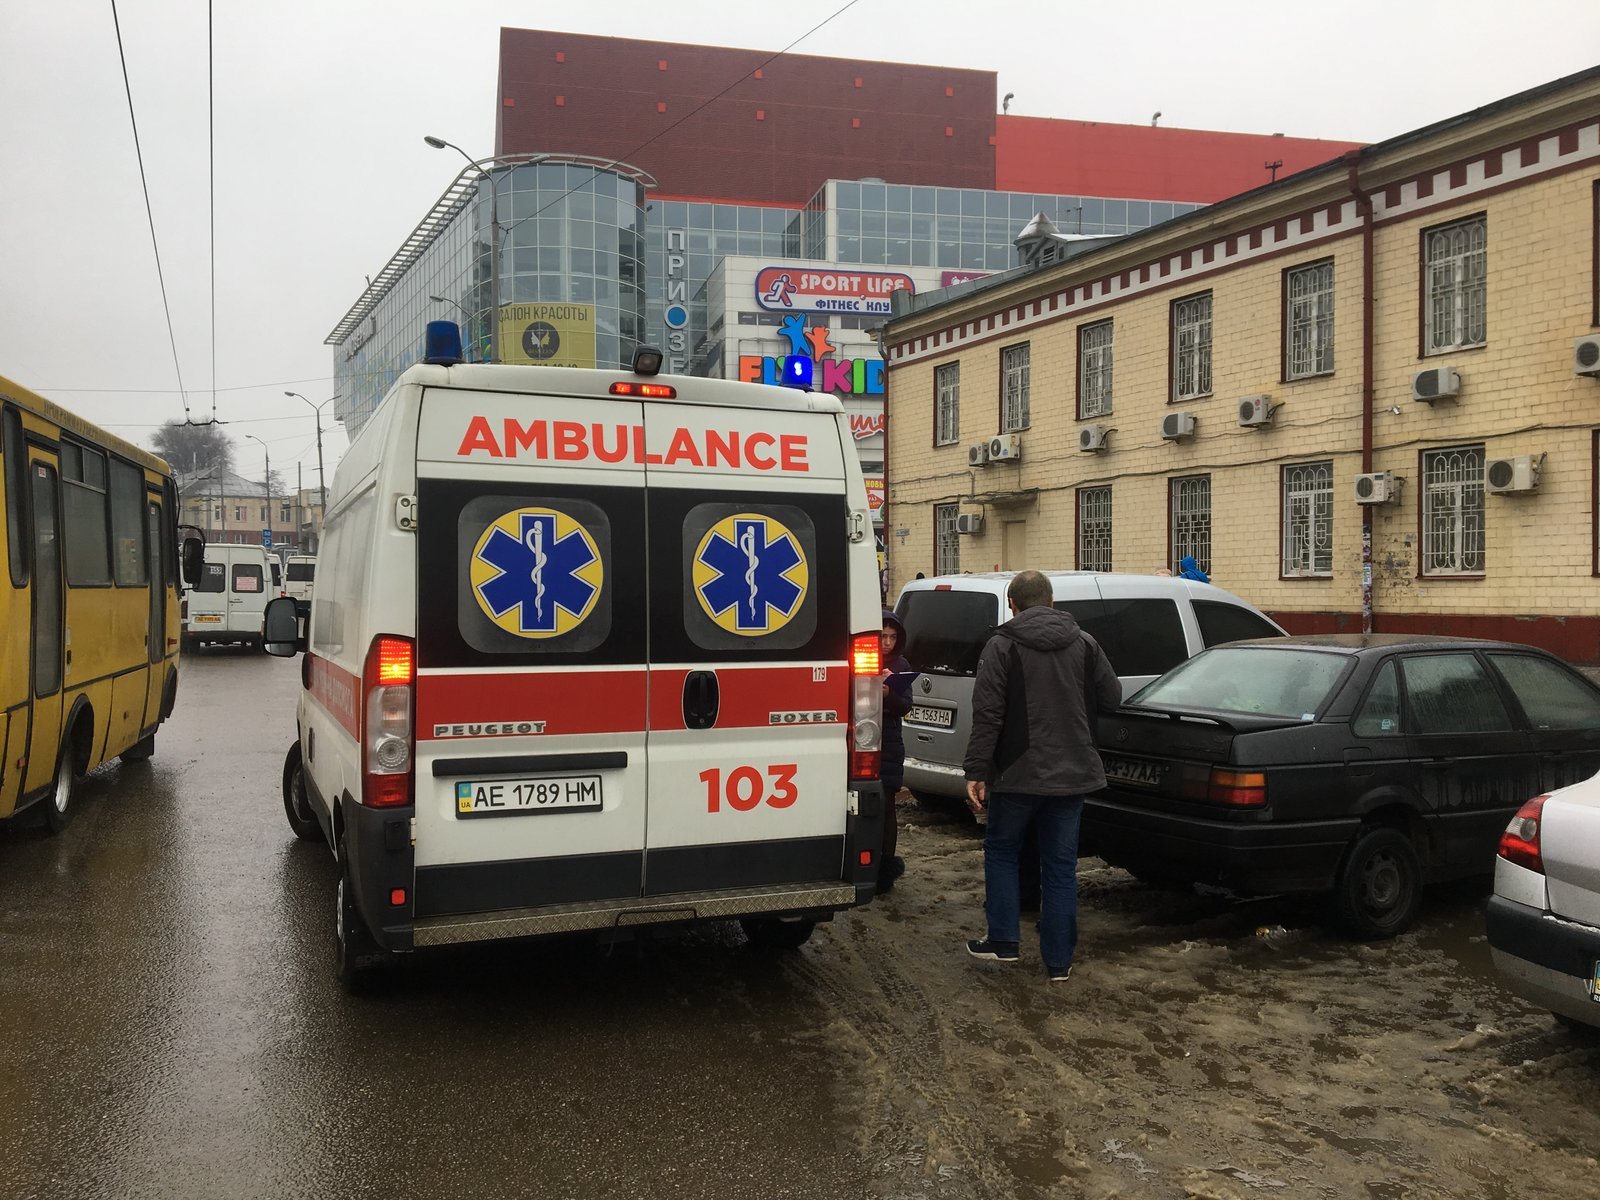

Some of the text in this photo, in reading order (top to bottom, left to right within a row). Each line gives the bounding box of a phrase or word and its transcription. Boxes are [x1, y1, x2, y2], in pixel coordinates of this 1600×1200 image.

[800, 274, 860, 292] SPORT
[533, 306, 588, 321] КРАСОТЫ
[815, 300, 860, 311] ФІТНЕС
[739, 355, 786, 386] FL
[457, 415, 809, 473] AMBULANCE
[814, 667, 826, 681] 179
[770, 711, 837, 723] BOXER
[435, 722, 545, 737] PEUGEOT
[474, 785, 506, 808] AE
[512, 783, 560, 805] 1789
[565, 781, 597, 803] HM
[699, 764, 798, 813] 103
